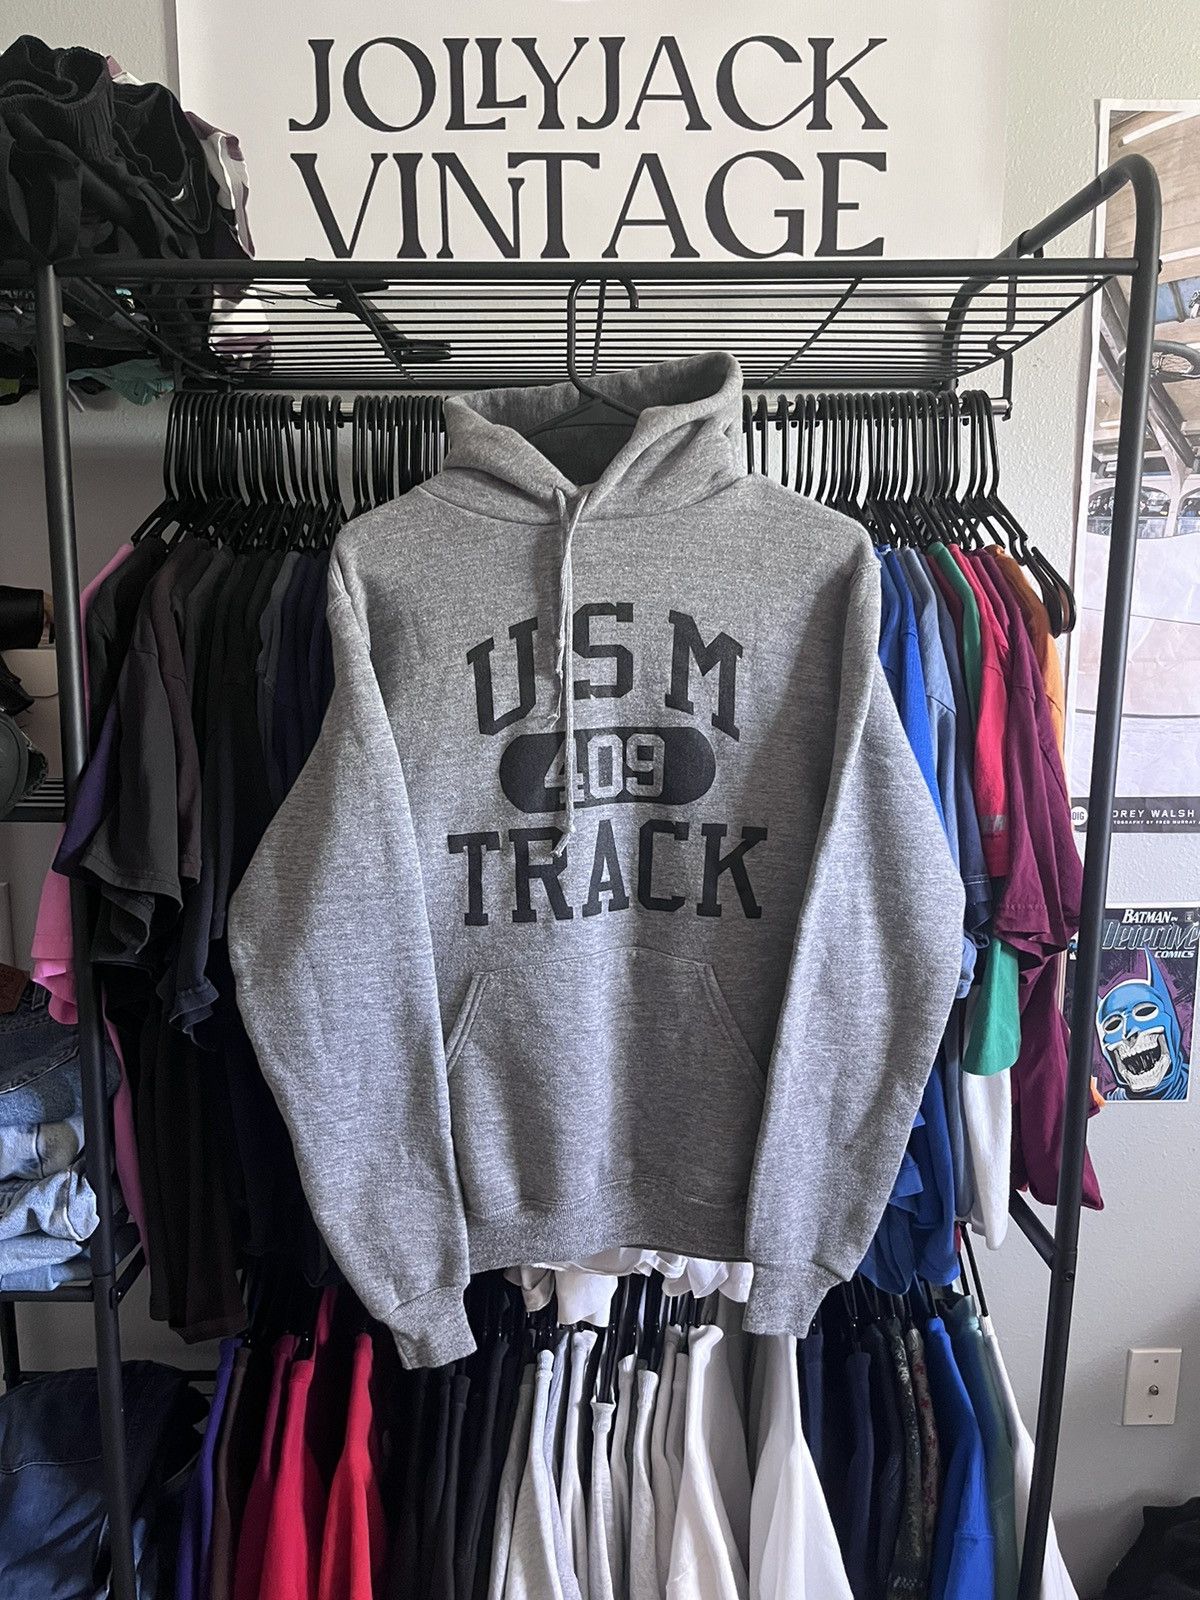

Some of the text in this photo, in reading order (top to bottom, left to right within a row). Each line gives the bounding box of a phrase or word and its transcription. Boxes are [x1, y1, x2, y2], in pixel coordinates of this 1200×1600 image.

[288, 36, 889, 132] JOLLYJACK
[289, 150, 887, 259] VINTAGE
[466, 602, 744, 742] USM
[543, 733, 666, 803] 409
[1112, 809, 1195, 818] OREY WALSH
[446, 819, 768, 926] TRACK
[1153, 950, 1196, 958] COMICS
